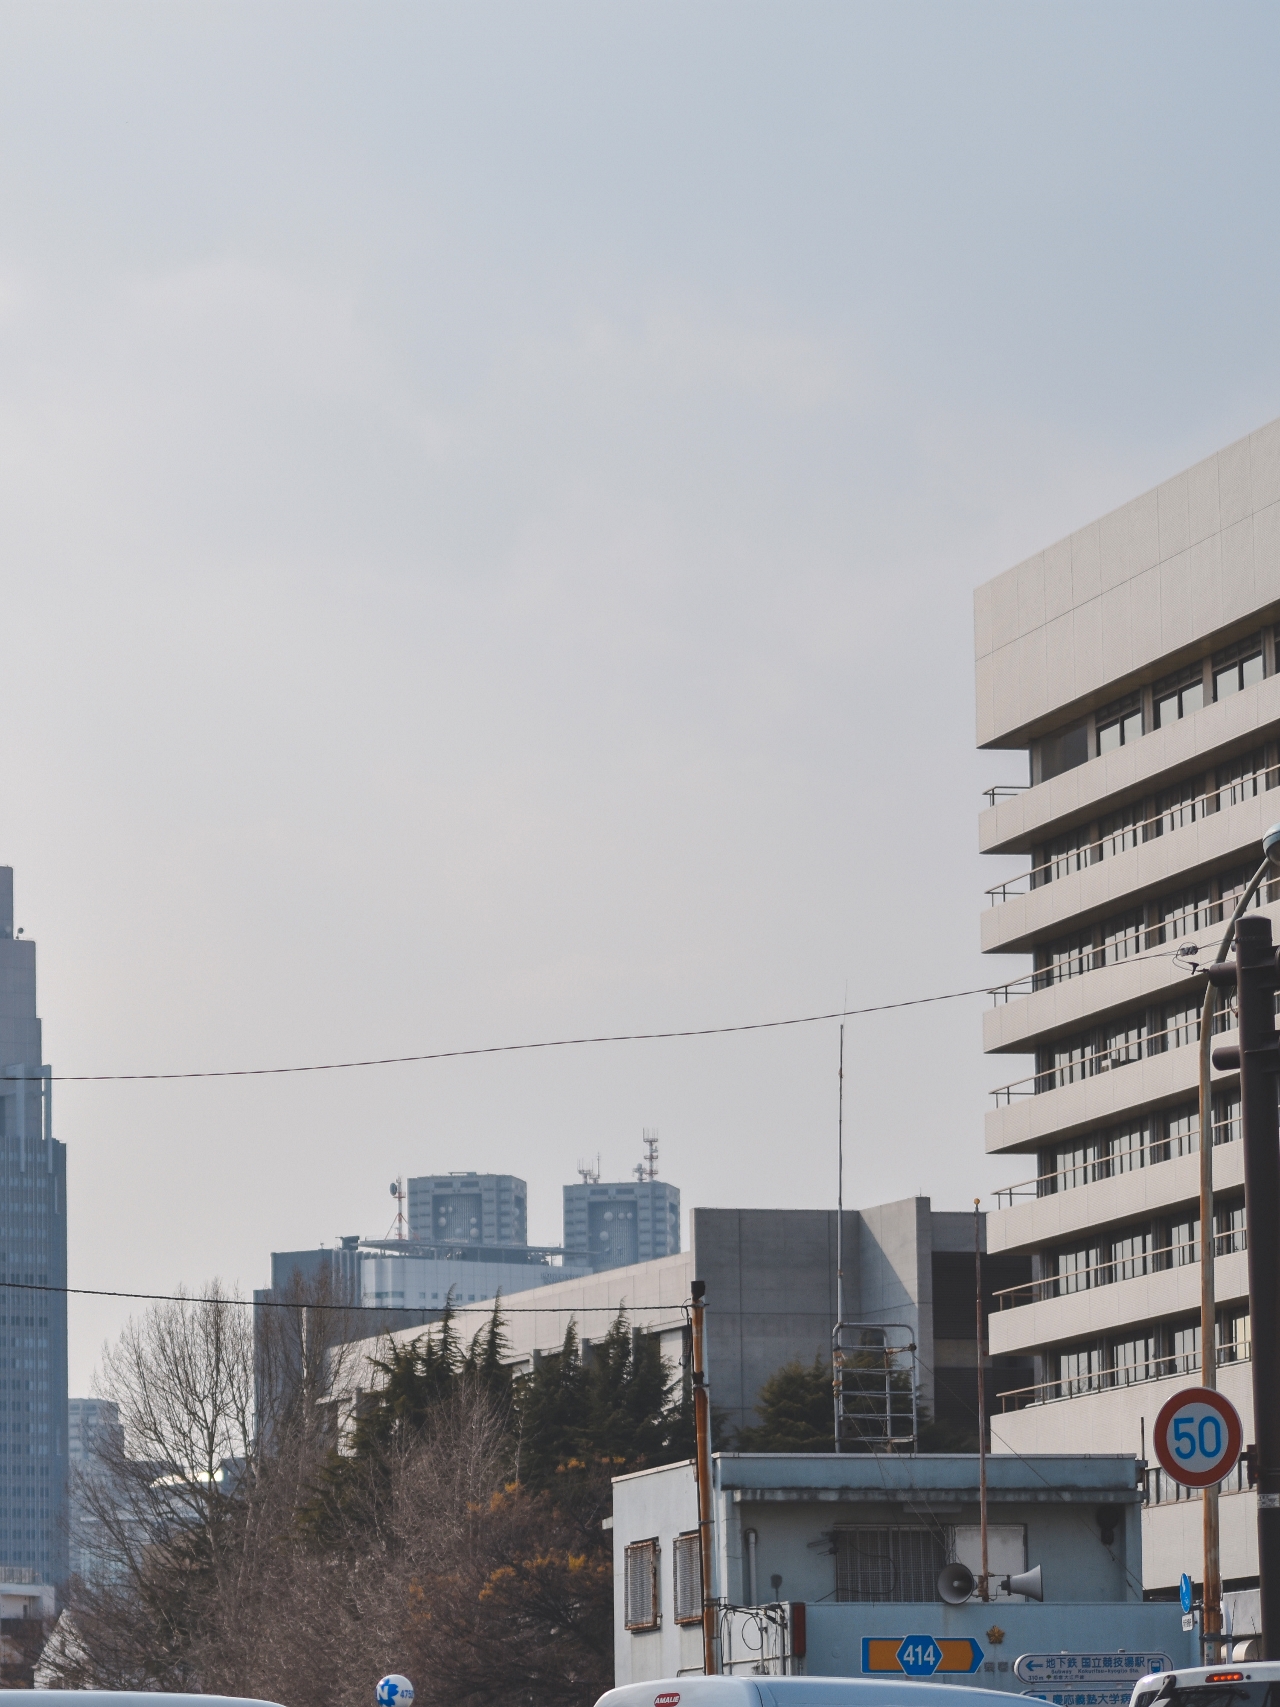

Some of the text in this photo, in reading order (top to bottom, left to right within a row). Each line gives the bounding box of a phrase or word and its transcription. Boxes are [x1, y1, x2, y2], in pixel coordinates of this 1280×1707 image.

[1173, 1415, 1222, 1460] 50
[903, 1644, 936, 1666] 414
[1046, 1656, 1145, 1669] 地下鉄 国立競技場駅
[654, 1695, 680, 1704] AMALIE
